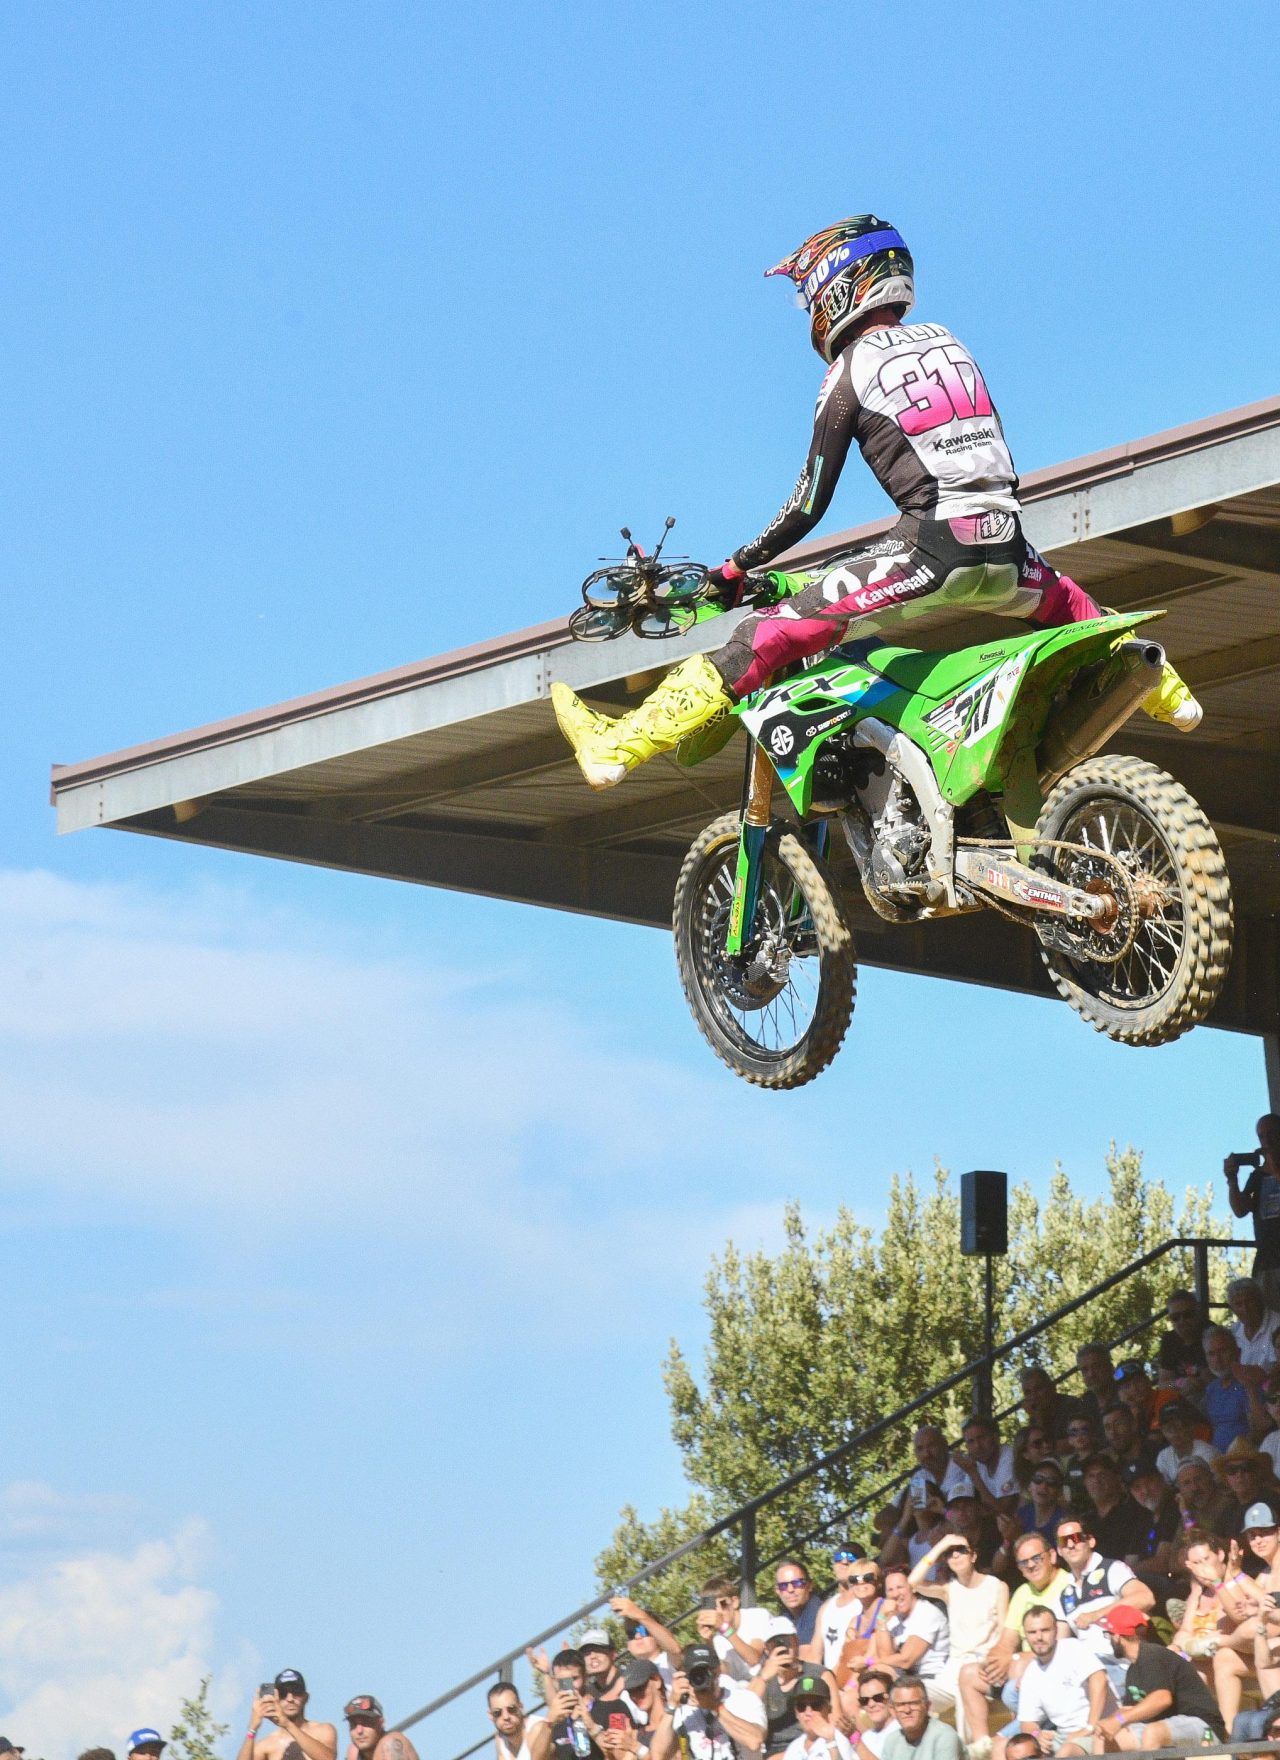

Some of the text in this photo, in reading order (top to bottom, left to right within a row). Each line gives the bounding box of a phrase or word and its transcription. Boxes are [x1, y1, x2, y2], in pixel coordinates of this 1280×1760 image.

[804, 246, 850, 302] 100%
[878, 343, 992, 436] 317
[932, 427, 995, 451] Kawasaki
[945, 440, 993, 456] Racing Team
[854, 564, 936, 609] Kawasaki
[979, 648, 1006, 661] Kawasaki
[757, 670, 849, 712] KX
